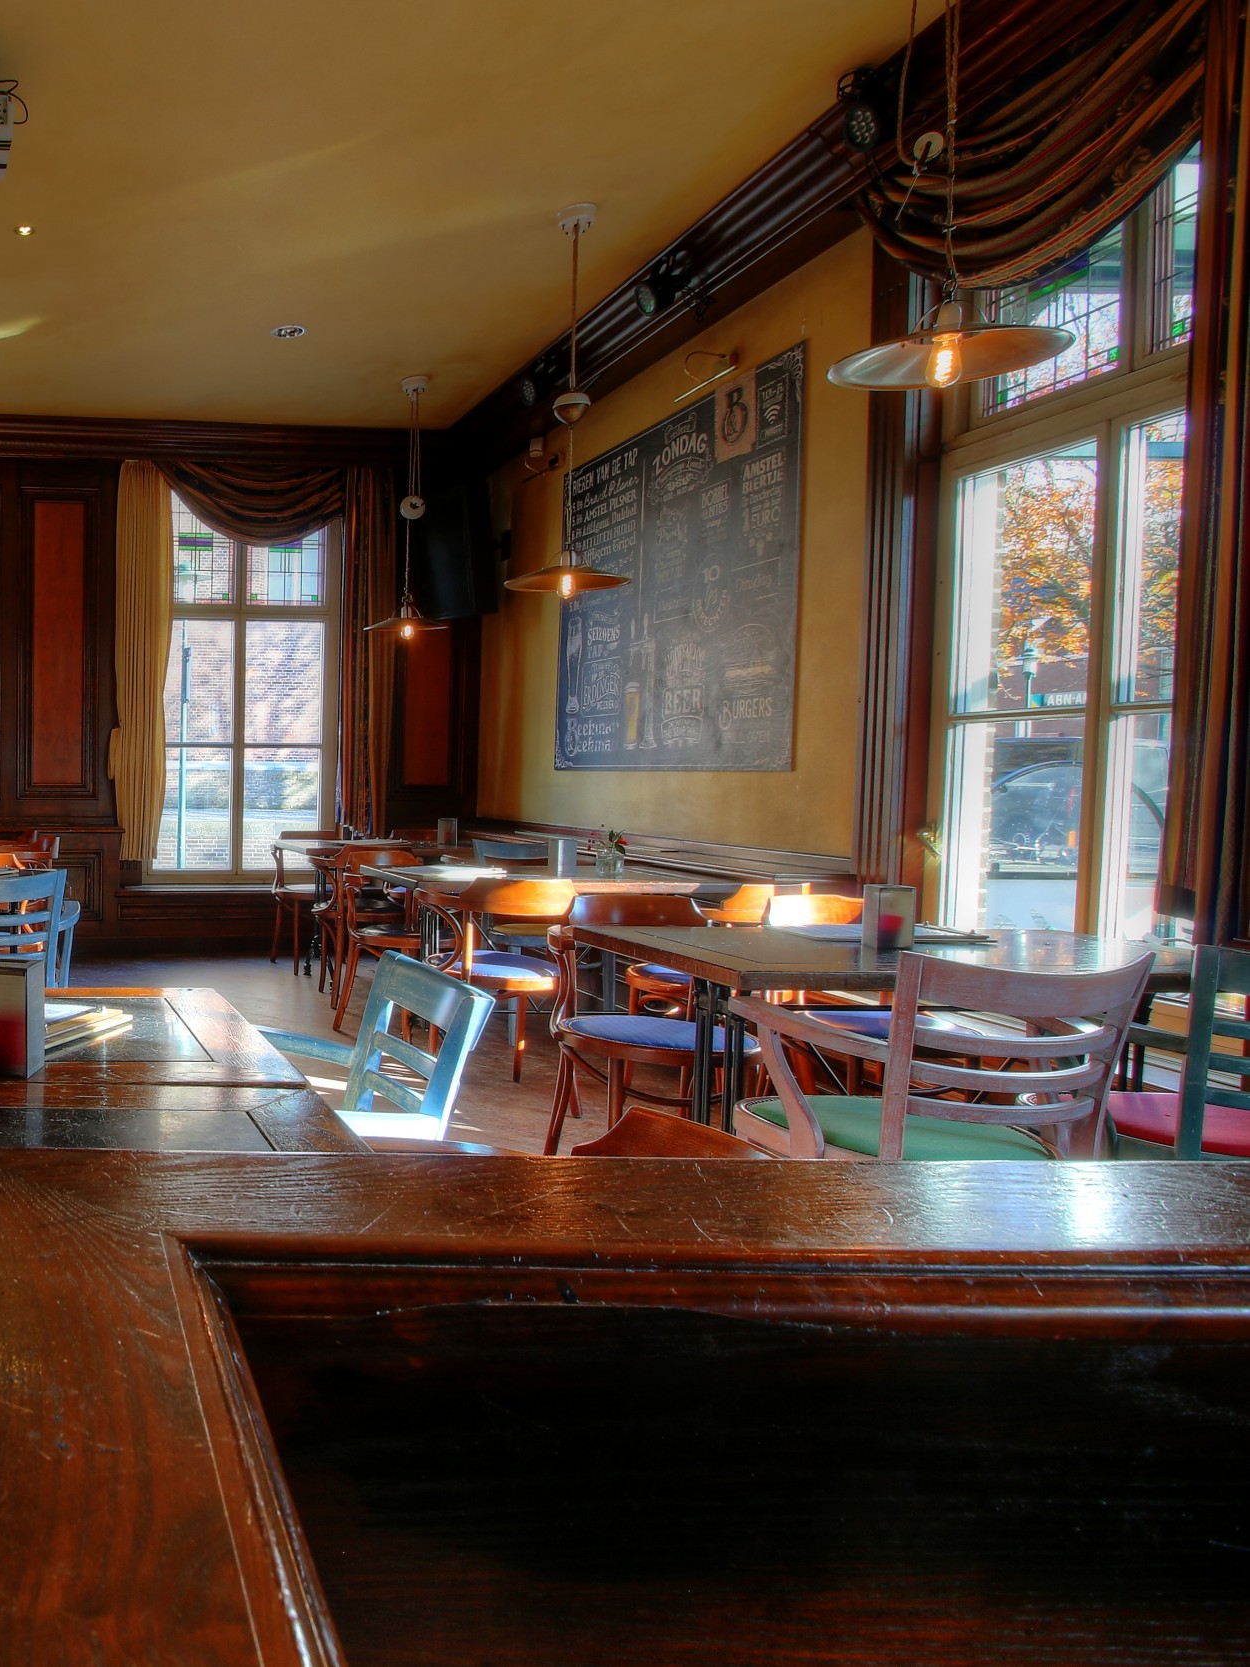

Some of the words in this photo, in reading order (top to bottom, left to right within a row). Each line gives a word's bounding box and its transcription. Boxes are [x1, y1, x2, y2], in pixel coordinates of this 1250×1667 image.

[652, 433, 708, 476] ZONDAG
[742, 452, 783, 481] AMSTEL
[572, 472, 594, 496] BIEREN
[596, 464, 610, 484] VAN
[612, 456, 621, 476] DE
[624, 447, 638, 470] TAP
[742, 469, 784, 495] BIERTJE
[584, 502, 608, 523] AMSTEL
[609, 489, 637, 511] PILSNER
[751, 506, 781, 529] EURO
[587, 624, 620, 646] SEIZOENS
[587, 644, 603, 659] TAP
[583, 674, 620, 706] ERDINGER
[719, 697, 773, 731] BURGERS
